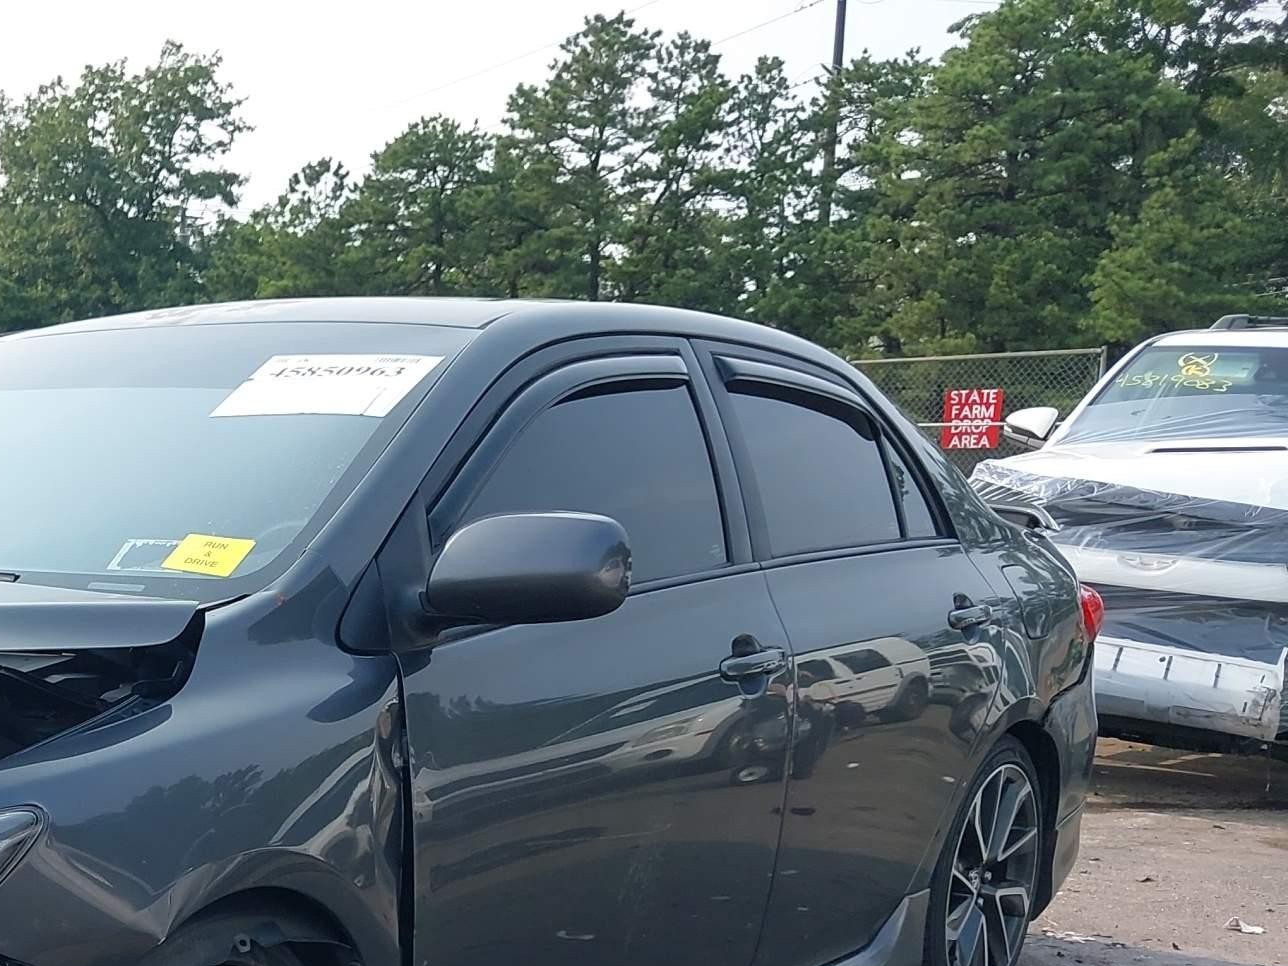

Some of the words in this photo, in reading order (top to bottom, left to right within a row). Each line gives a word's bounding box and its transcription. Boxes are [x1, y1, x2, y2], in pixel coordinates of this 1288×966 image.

[270, 366, 406, 378] 45850963
[950, 389, 998, 404] STATE
[952, 404, 995, 418] FARM
[951, 418, 992, 434] DROP
[948, 435, 990, 449] AREA
[203, 541, 230, 550] RUN
[184, 557, 220, 568] DRIVE
